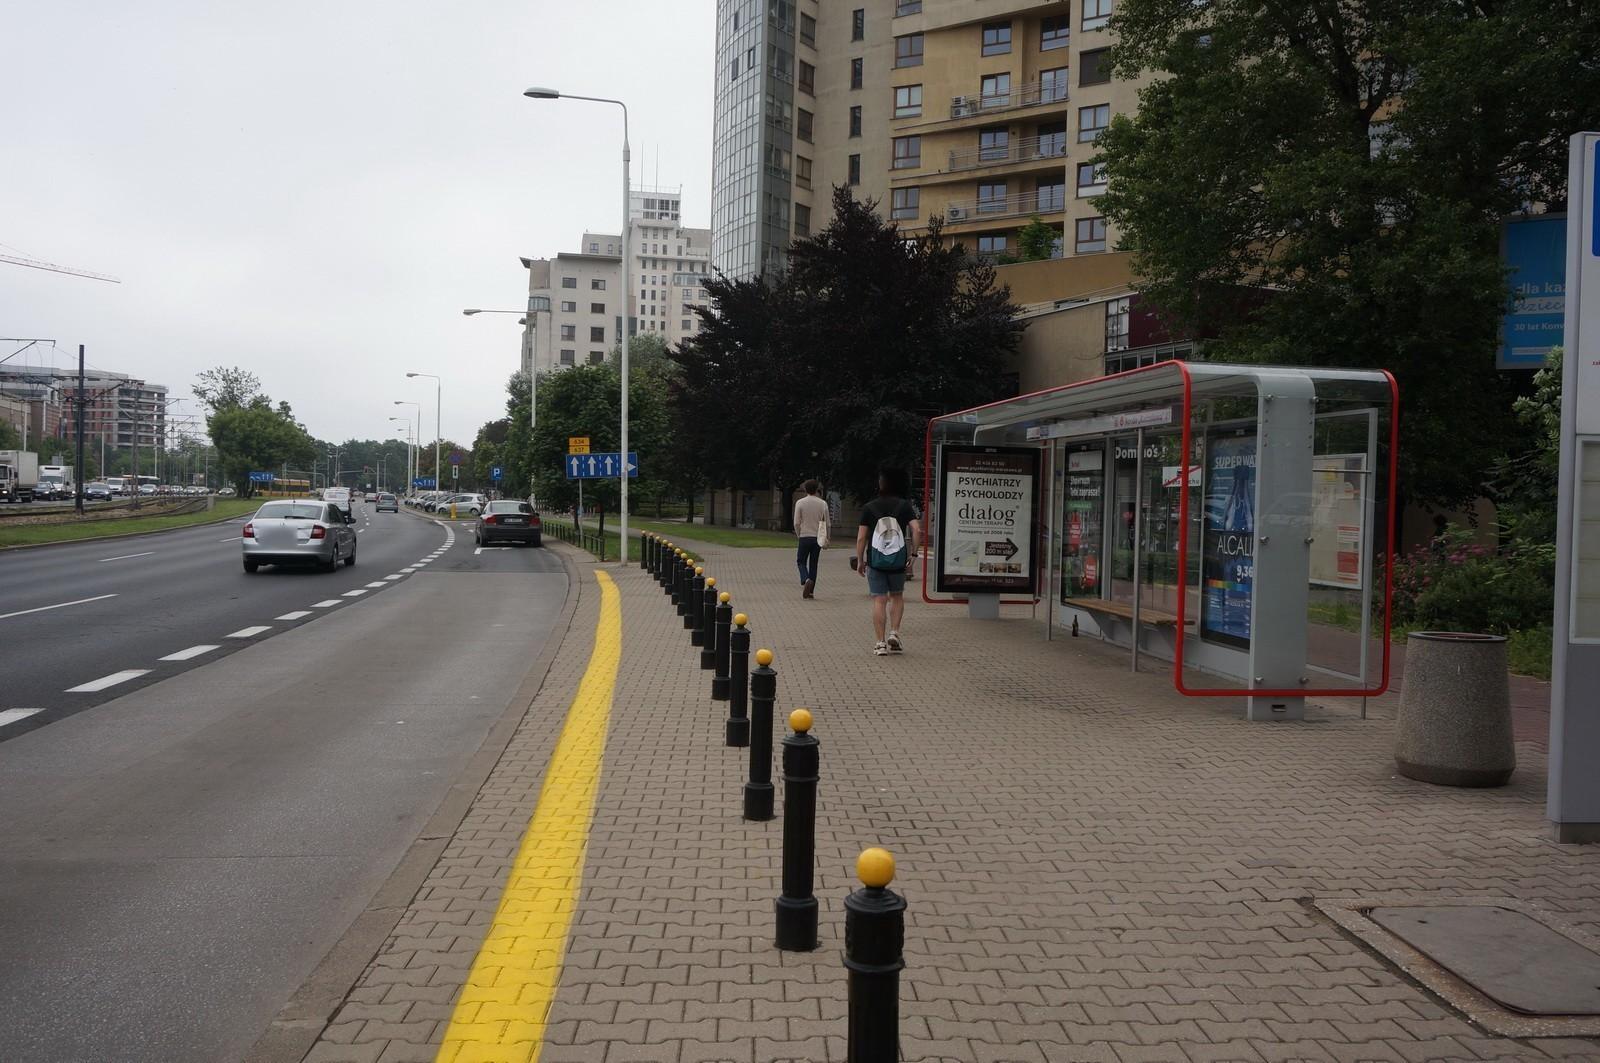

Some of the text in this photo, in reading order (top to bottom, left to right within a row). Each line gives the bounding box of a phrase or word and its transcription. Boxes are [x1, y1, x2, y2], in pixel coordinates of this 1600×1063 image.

[1514, 282, 1539, 295] dla
[1115, 443, 1159, 459] Domo's
[958, 476, 1021, 488] PSYCHIATRZY
[955, 489, 1024, 500] PSYCHOLODZY
[958, 503, 1016, 526] dialog
